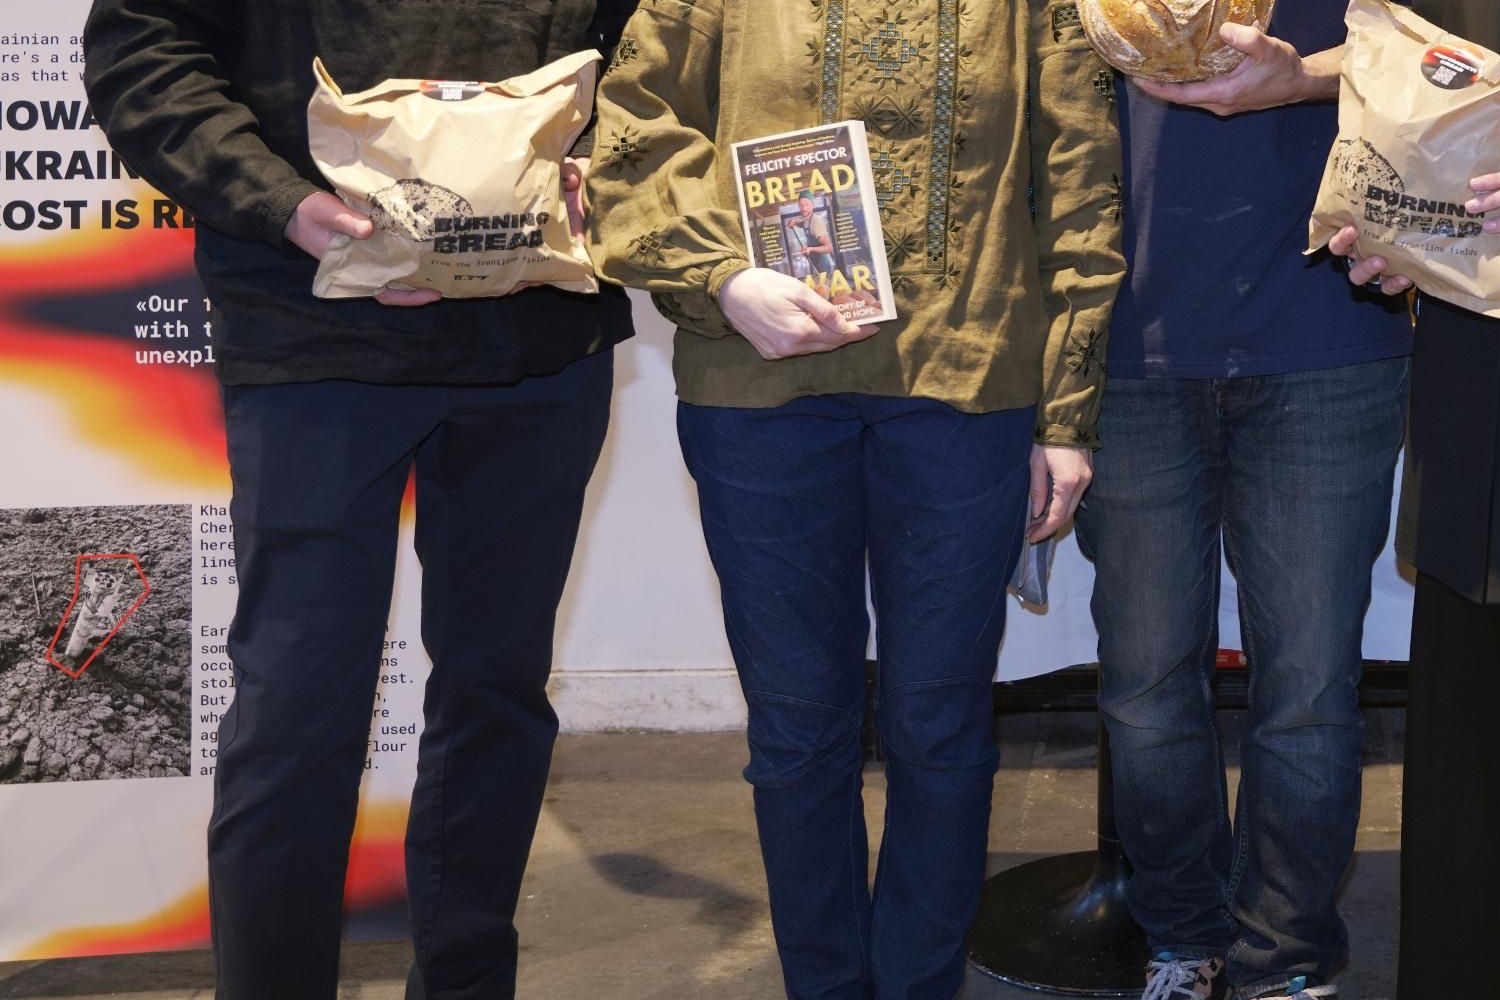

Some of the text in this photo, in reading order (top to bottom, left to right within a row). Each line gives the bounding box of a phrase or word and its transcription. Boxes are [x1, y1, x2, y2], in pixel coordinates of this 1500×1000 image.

[1, 34, 59, 46] ainian
[2, 51, 40, 64] re's
[51, 53, 59, 64] a
[1, 71, 20, 82] as
[32, 69, 69, 82] that
[0, 100, 101, 131] OWA
[0, 150, 139, 180] KRAIN
[745, 147, 848, 176] FELICITY SPECTOR
[745, 164, 855, 208] BREAD
[0, 200, 88, 230] OST
[101, 200, 140, 230] IS
[434, 211, 551, 233] BURNING
[1364, 202, 1483, 239] BREAD
[434, 229, 544, 254] BREAD
[1400, 241, 1445, 253] frontline
[1449, 247, 1478, 257] fields
[136, 294, 189, 313] «Our
[833, 302, 855, 311] TORY
[135, 321, 189, 338] with
[136, 346, 216, 367] unexpl
[200, 505, 227, 517] Kha
[200, 539, 236, 551] here
[201, 557, 236, 569] line
[201, 574, 218, 585] is
[201, 626, 229, 637] Ear
[200, 694, 227, 706] But
[381, 723, 416, 735] used
[201, 748, 218, 759] to
